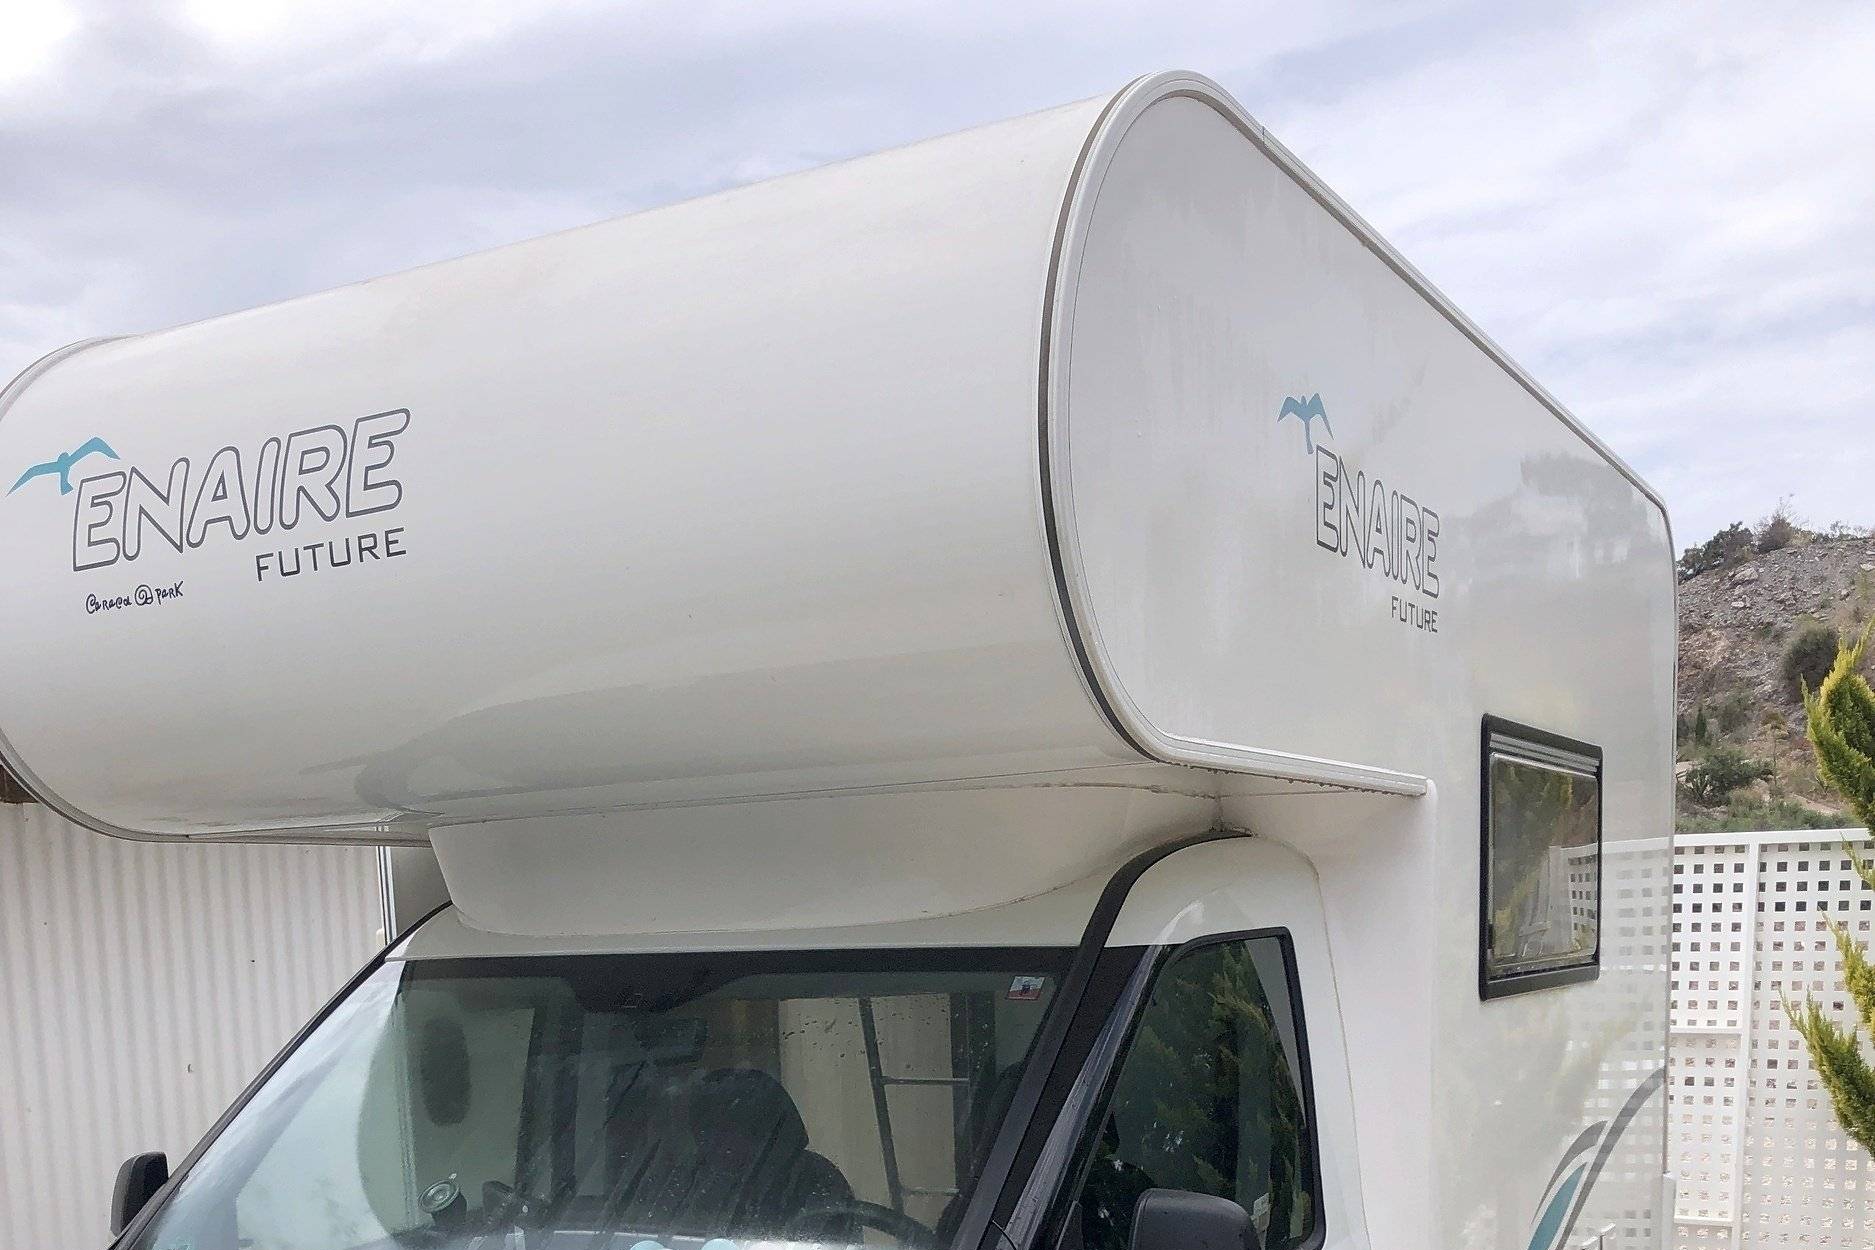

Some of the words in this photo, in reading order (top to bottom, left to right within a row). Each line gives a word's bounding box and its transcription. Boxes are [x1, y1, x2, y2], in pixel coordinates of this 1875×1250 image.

[73, 408, 411, 572] ENAIRE
[1315, 444, 1440, 599] ENAIRE
[255, 527, 407, 582] FUTURE
[1391, 595, 1439, 633] FUTURE
